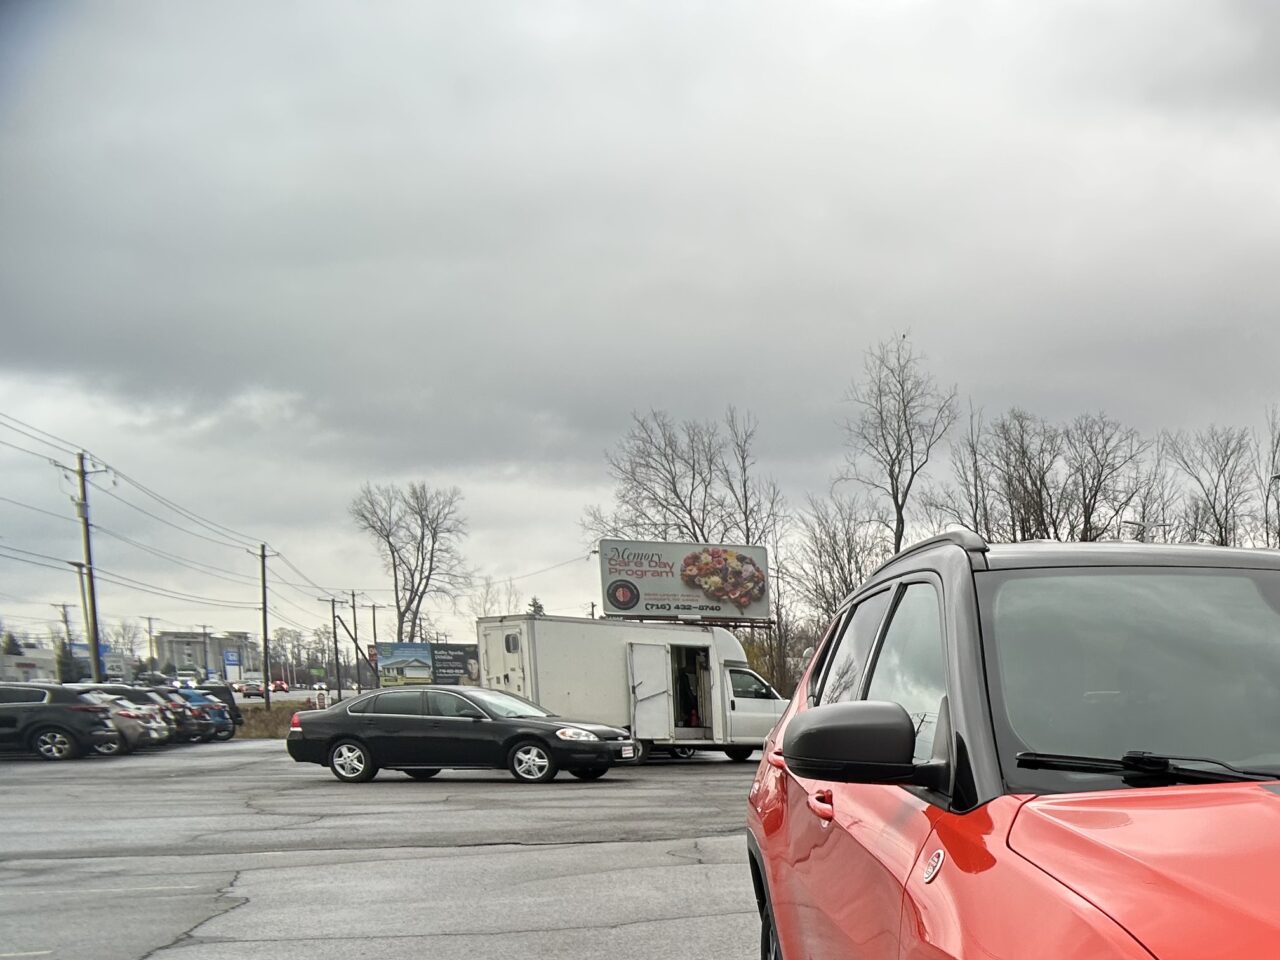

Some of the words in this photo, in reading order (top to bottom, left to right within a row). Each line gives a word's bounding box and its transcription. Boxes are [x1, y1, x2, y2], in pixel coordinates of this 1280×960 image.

[609, 547, 663, 562] Memory
[608, 558, 644, 568] Care
[648, 560, 675, 571] Day
[608, 567, 674, 579] Program
